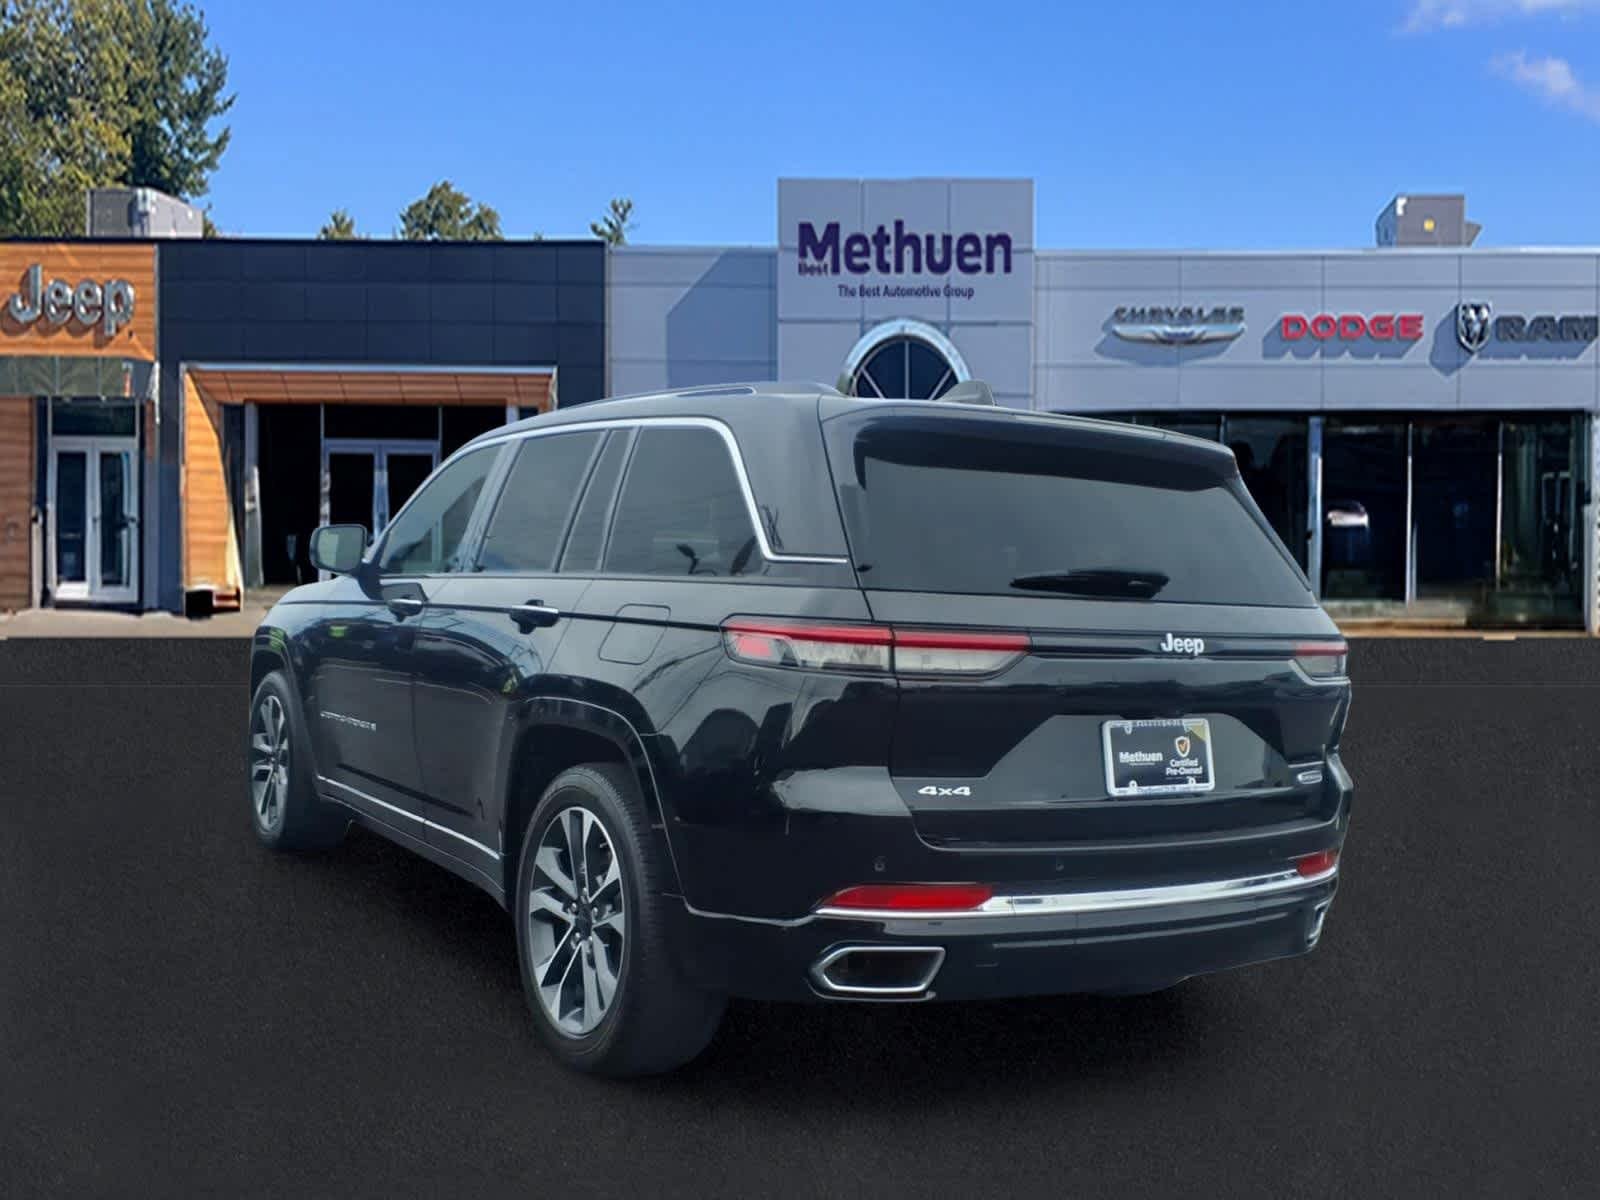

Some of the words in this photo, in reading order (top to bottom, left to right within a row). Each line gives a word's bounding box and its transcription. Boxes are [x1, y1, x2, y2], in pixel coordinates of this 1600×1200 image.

[798, 219, 1012, 275] Methuen
[798, 262, 829, 276] Best
[9, 263, 135, 336] Jeep
[838, 284, 857, 297] The
[859, 284, 881, 297] Best
[883, 284, 941, 297] Automotive
[943, 284, 975, 300] Group
[1113, 306, 1245, 322] CHRYSLER
[1281, 314, 1424, 340] DODGE
[1496, 315, 1599, 343] RAM
[1160, 633, 1205, 656] Jeep
[1119, 751, 1163, 763] Methuen
[917, 785, 972, 797] 4x4
